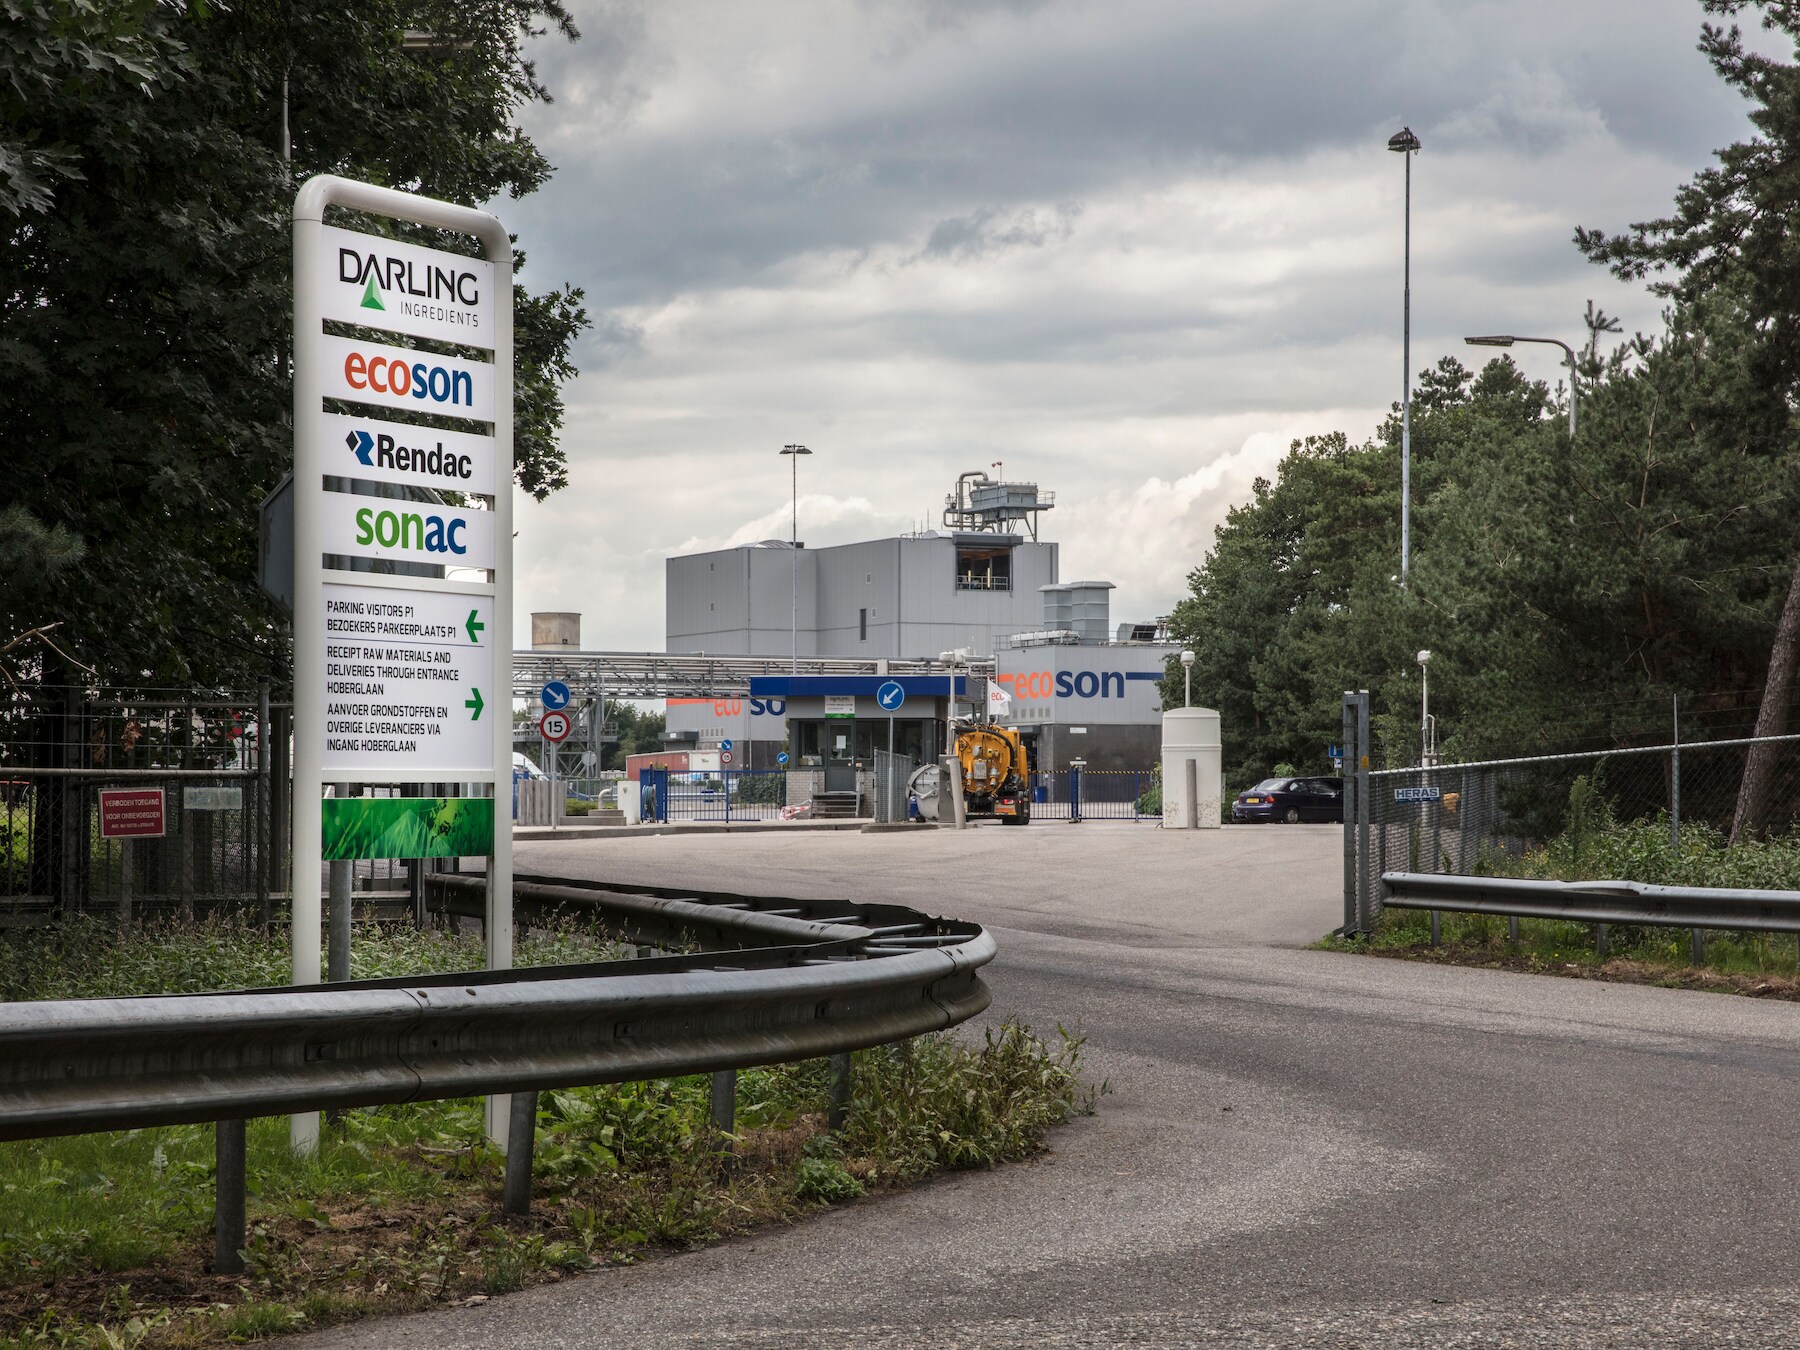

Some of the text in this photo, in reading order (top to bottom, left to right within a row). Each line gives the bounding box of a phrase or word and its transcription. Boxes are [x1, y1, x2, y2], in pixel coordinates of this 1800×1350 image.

[340, 248, 478, 306] DARLING
[400, 302, 478, 327] INGREDIENTS
[345, 353, 472, 406] ecoson
[378, 434, 472, 479] Rendac
[356, 508, 467, 554] sonac
[328, 600, 414, 618] PARKING VISITORS P1
[328, 619, 456, 638] BEZOEKERS PARKEERPLAATS P1
[328, 646, 451, 664] RECEIPT RAW MATERIALS AND
[328, 664, 459, 681] DELIVERIES THROUGH ENTRANCE
[328, 682, 384, 695] HOBERGLAAN
[1014, 671, 1125, 700] ecoson
[328, 703, 448, 718] AANVOER GRONDSTOFFEN EN
[328, 721, 441, 735] OVERIGE LEVERANCIERS VIA
[548, 720, 562, 733] 15
[328, 739, 416, 752] INGANG HOBERGLAAN
[1396, 788, 1438, 798] HERAS
